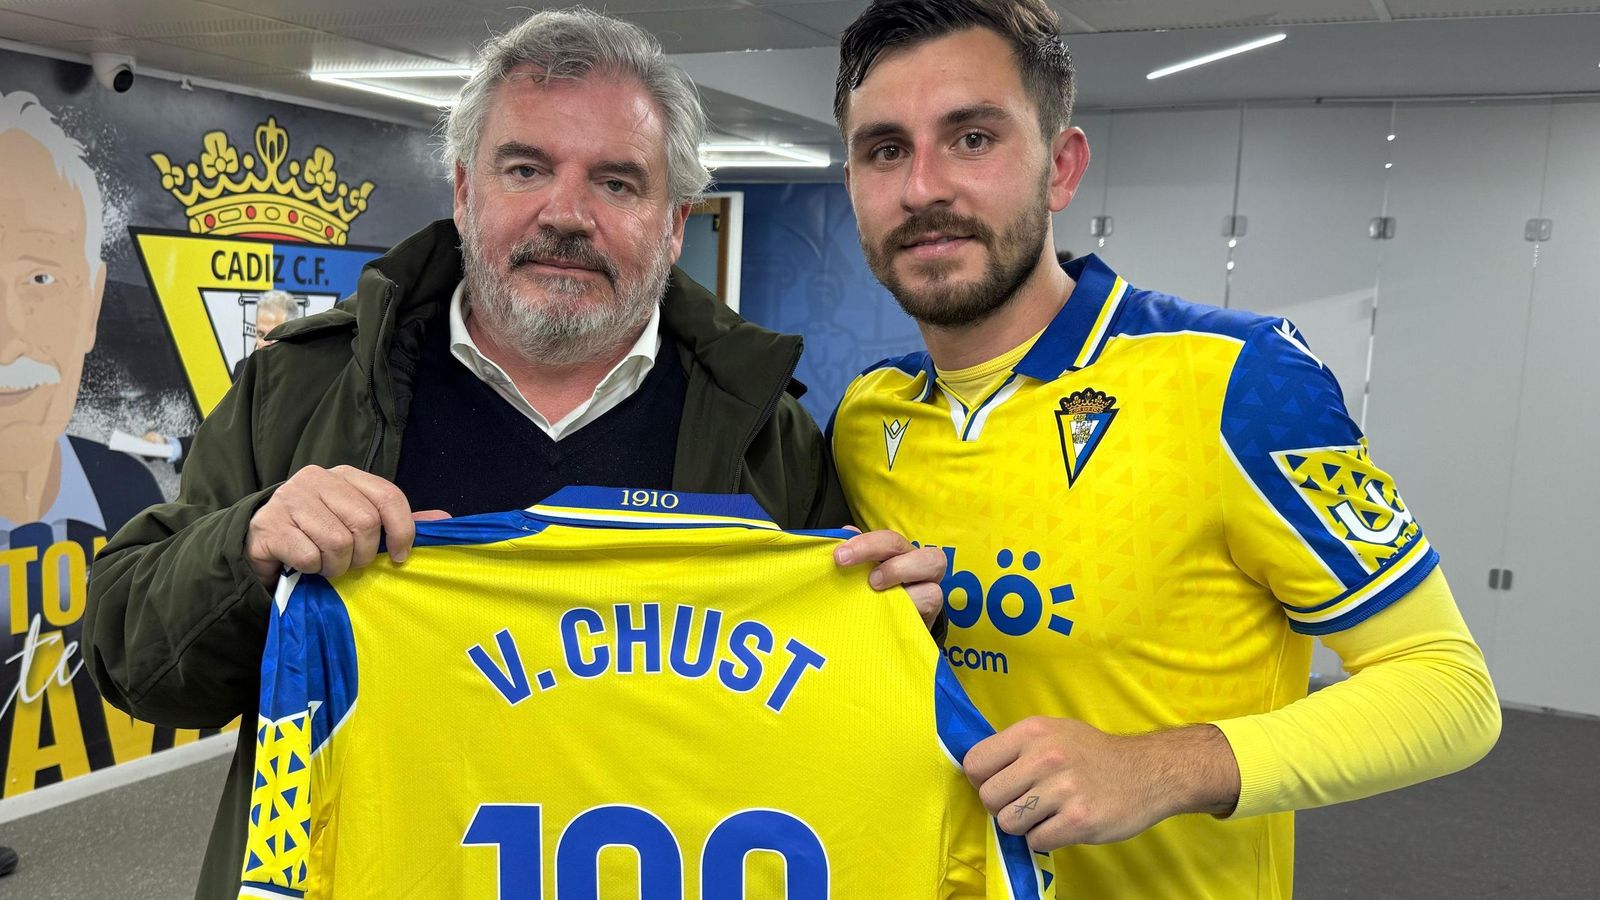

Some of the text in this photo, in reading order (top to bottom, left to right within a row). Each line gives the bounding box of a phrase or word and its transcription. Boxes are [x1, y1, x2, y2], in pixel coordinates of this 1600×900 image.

[211, 250, 330, 286] CADIZ C.F.
[620, 489, 679, 509] 1910
[0, 536, 108, 635] TO
